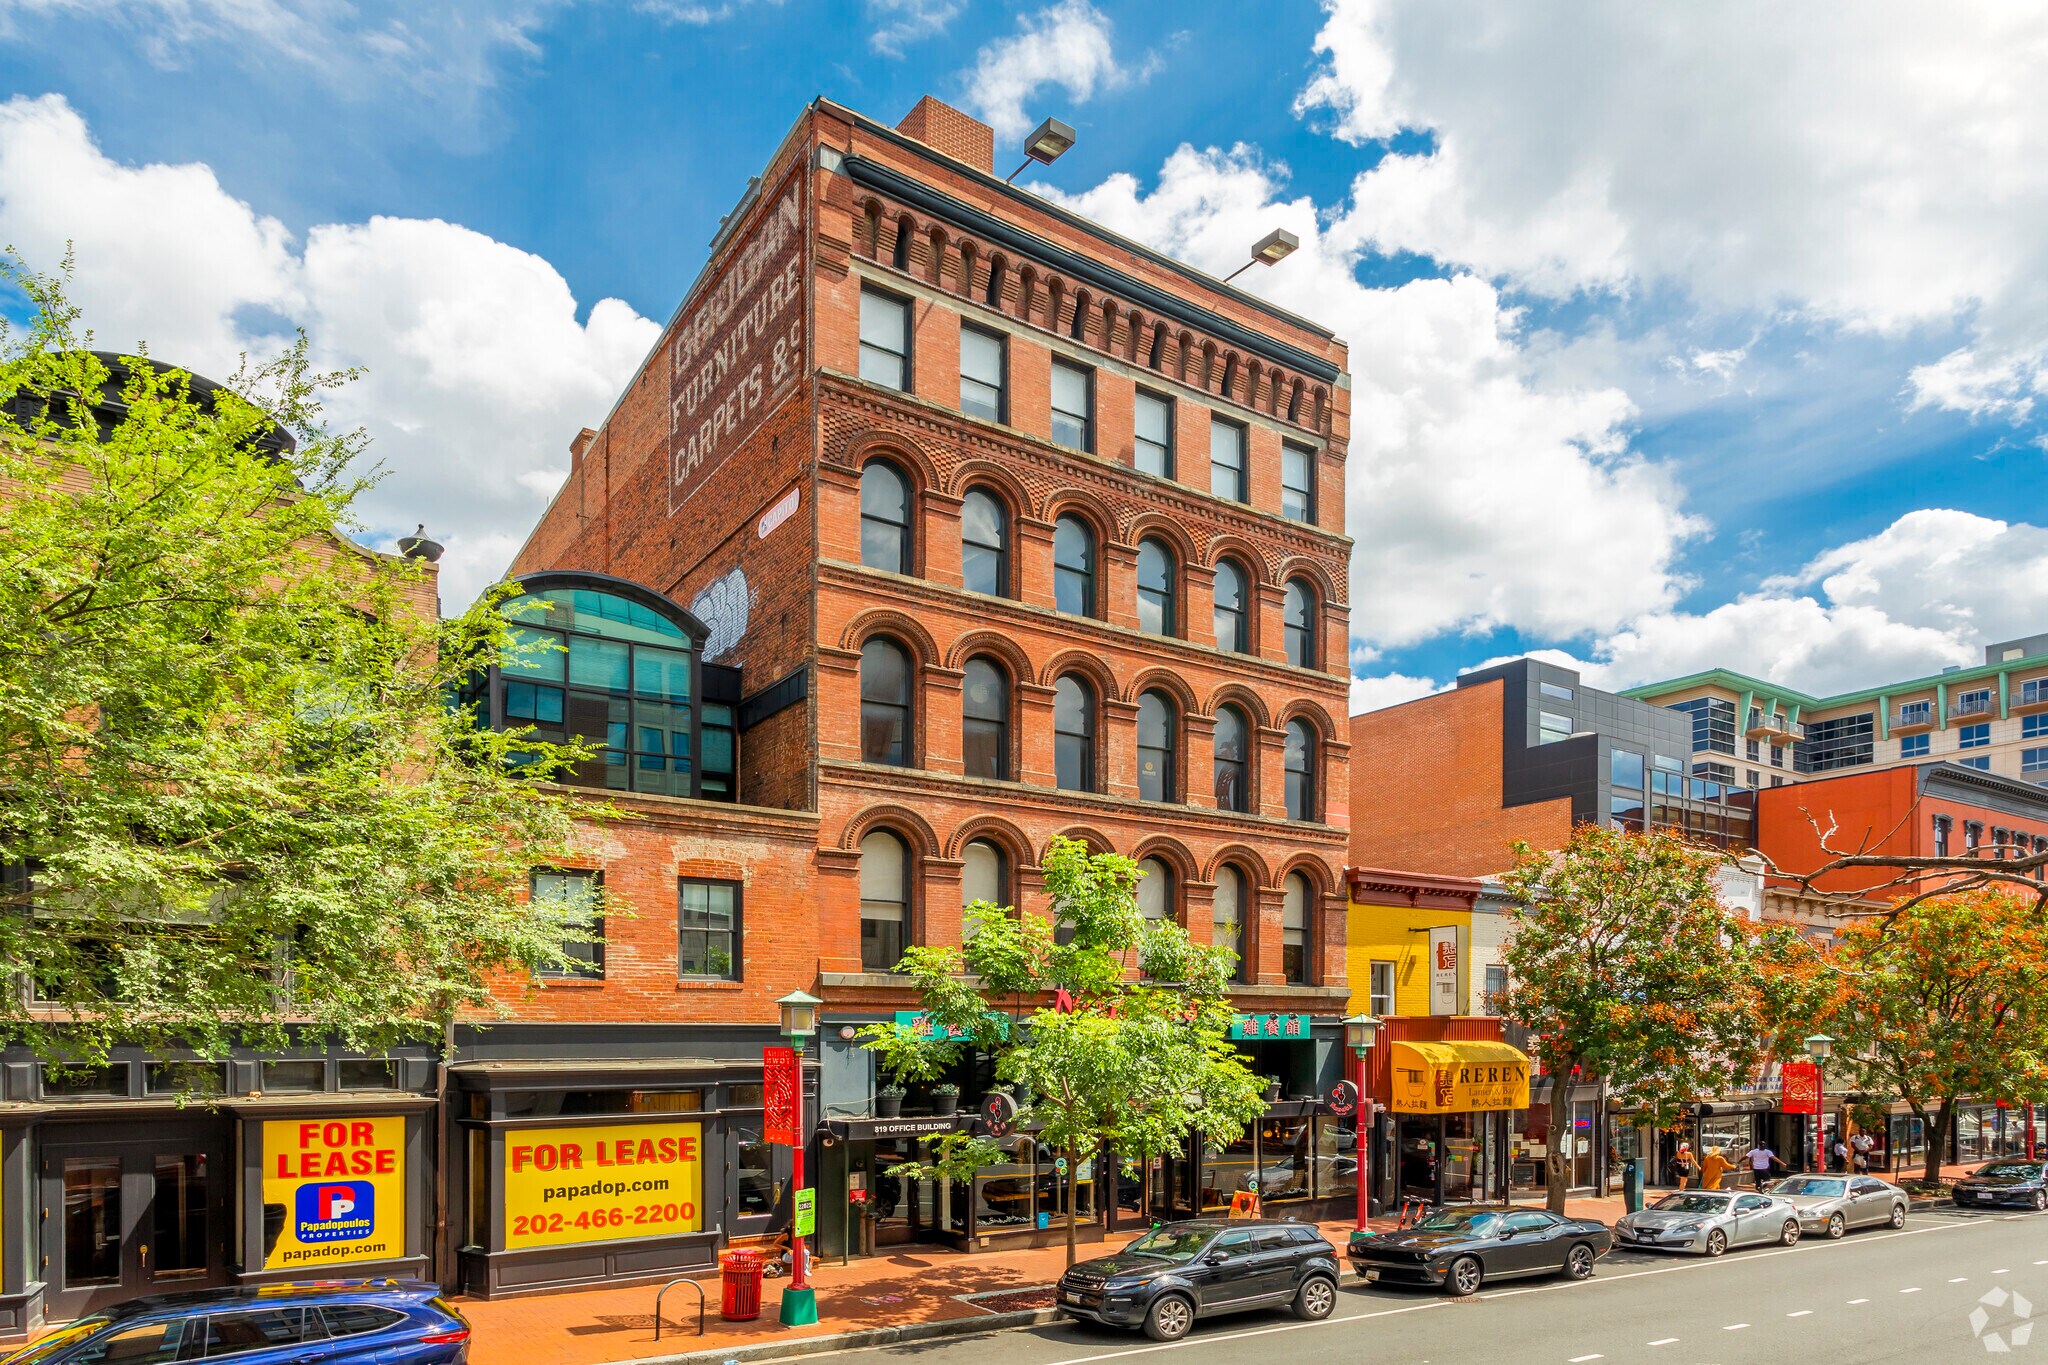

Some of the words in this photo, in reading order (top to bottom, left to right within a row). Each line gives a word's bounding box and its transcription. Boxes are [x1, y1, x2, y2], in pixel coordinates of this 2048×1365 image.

[671, 252, 800, 434] FURNITURE
[675, 363, 763, 486] CARPETS
[70, 1075, 98, 1087] 827
[1460, 1066, 1525, 1083] REREN
[299, 1122, 375, 1149] FOR
[874, 1125, 887, 1133] 819
[889, 1124, 915, 1132] OFFICE
[917, 1122, 951, 1131] BUILDING
[277, 1149, 395, 1179] LEASE
[512, 1143, 583, 1173] FOR
[596, 1137, 696, 1167] LEASE
[543, 1179, 669, 1202] papadop.com
[300, 1218, 370, 1232] Papadopoulos
[513, 1202, 696, 1236] 202-466-2200
[301, 1229, 370, 1239] PROPERTIES
[283, 1242, 386, 1262] papadop.com
